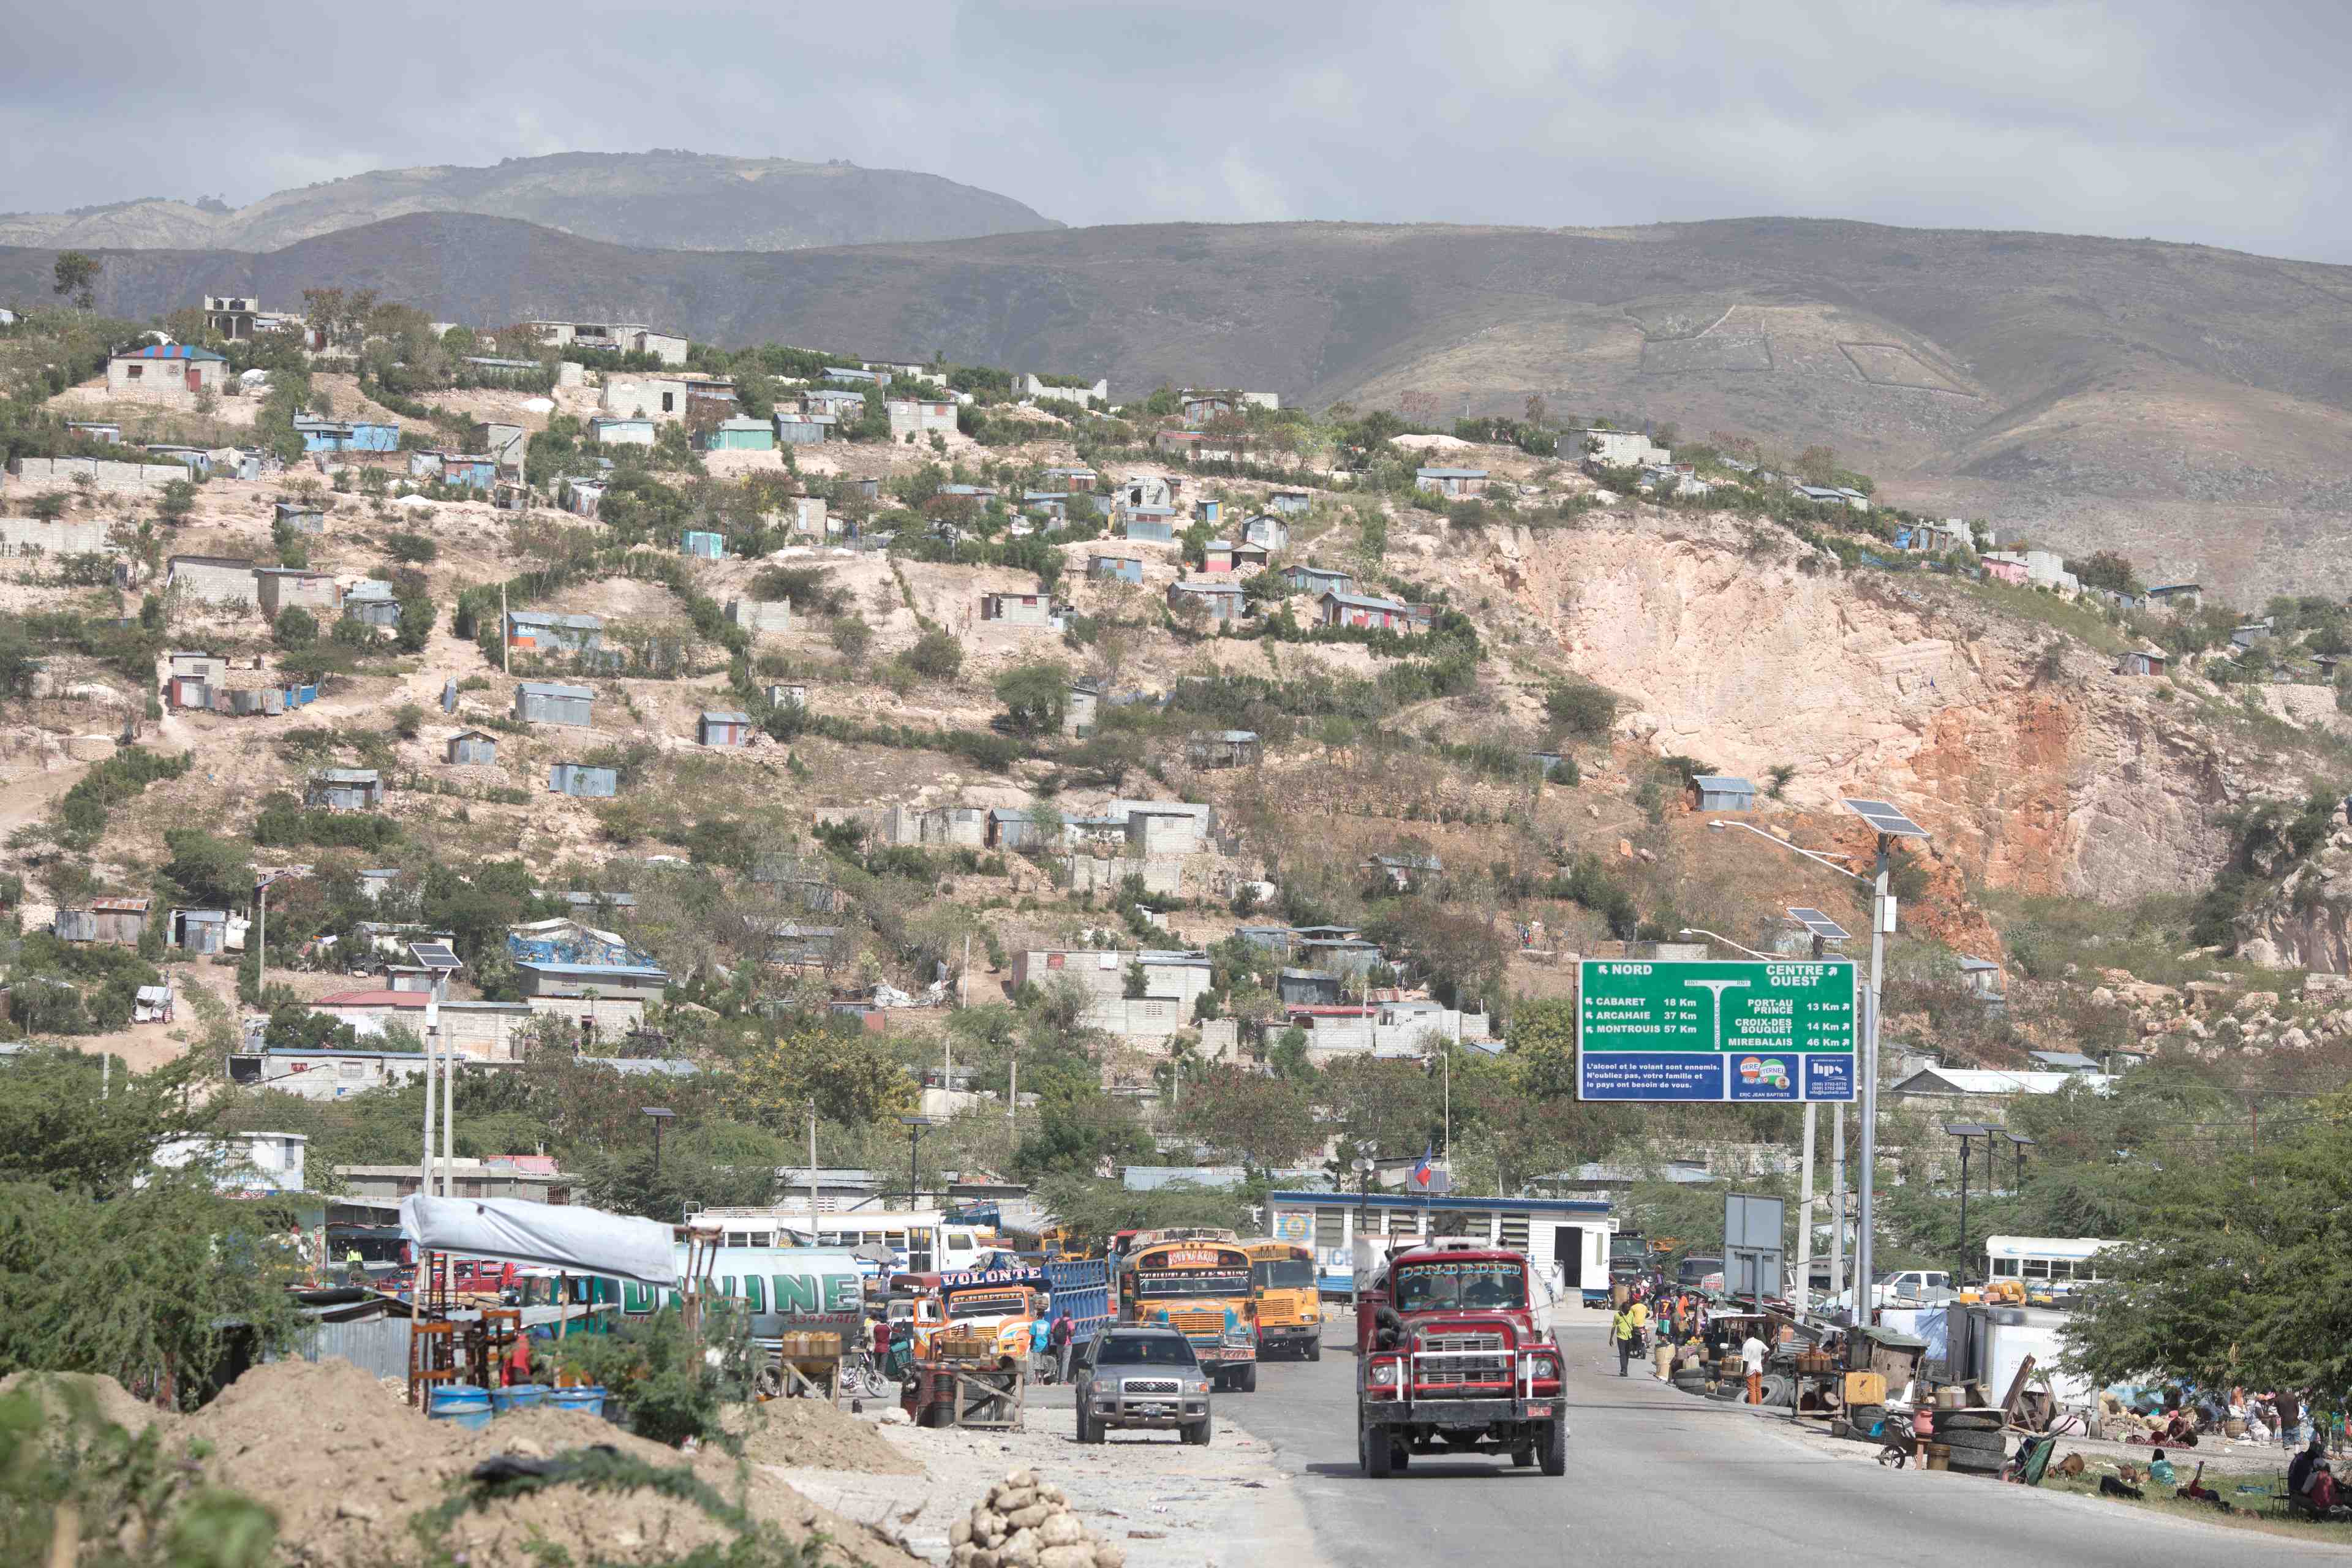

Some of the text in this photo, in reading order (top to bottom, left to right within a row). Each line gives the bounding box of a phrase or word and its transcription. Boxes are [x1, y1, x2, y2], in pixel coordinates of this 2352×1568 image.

[1611, 964, 1653, 975] NORD
[1766, 965, 1823, 976] CENTRE
[1770, 976, 1819, 986] OUEST
[1596, 997, 1646, 1006] CABARET
[1664, 998, 1676, 1006] 18
[1596, 1011, 1651, 1020] ARCAHAIE
[1735, 1018, 1792, 1027] CROIX-DES
[1596, 1025, 1660, 1033] MONTROUIS
[1664, 1025, 1676, 1033] 57
[1813, 1063, 1843, 1077] hps
[940, 1267, 1042, 1286] VOLONTE
[1662, 1302, 1670, 1313] 7
